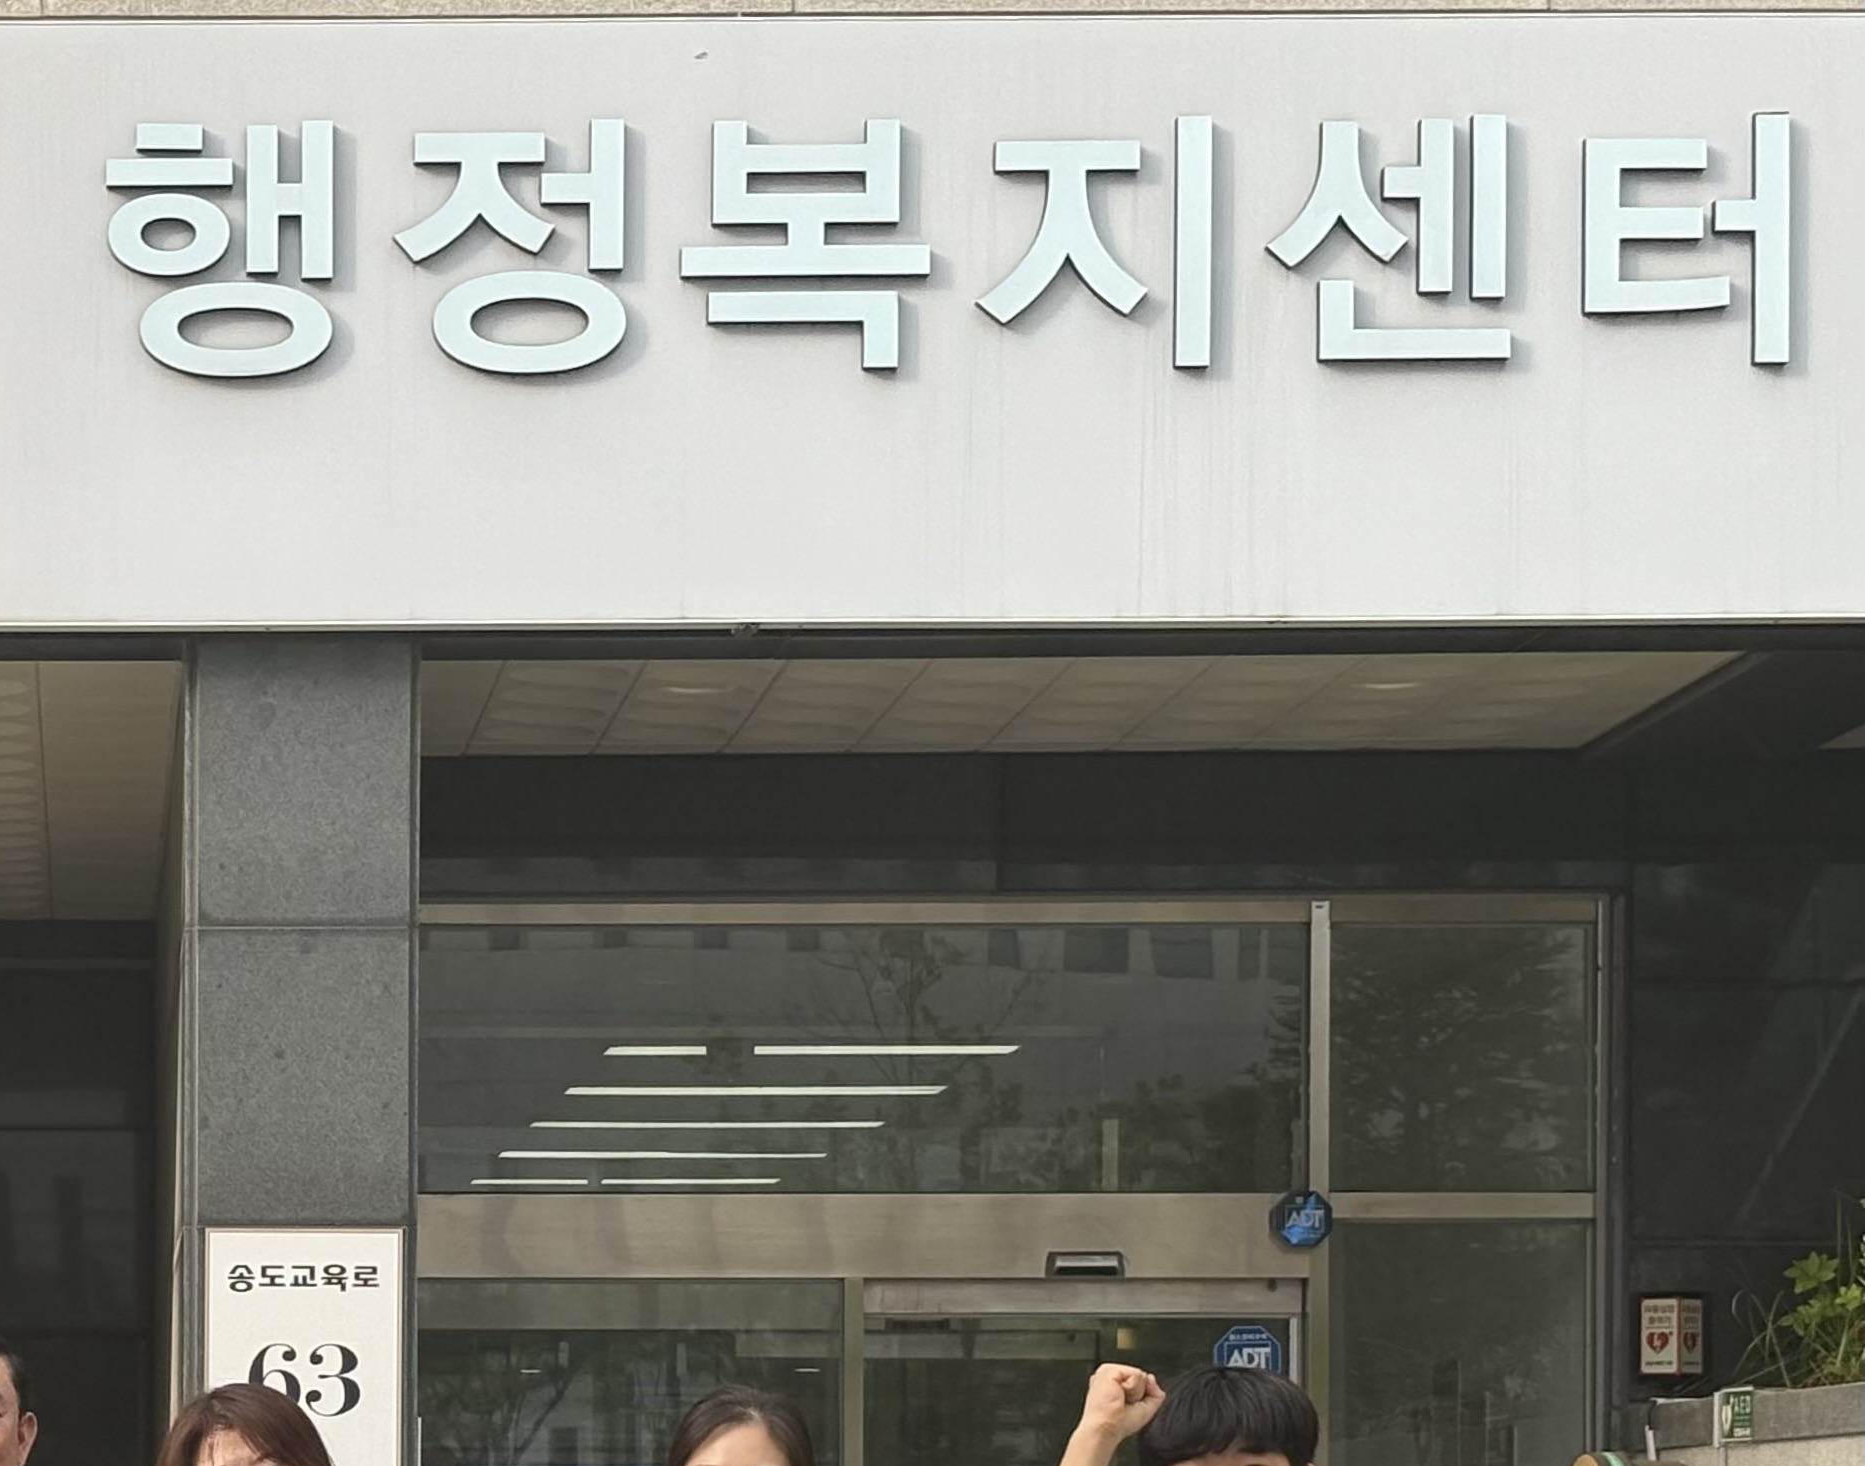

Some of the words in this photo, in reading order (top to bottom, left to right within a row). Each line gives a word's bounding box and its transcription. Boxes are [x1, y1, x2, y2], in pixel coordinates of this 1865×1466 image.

[106, 112, 1790, 377] 행정복지센터
[1285, 1209, 1325, 1228] ADT
[227, 1264, 380, 1293] 송도교육로
[1227, 1347, 1271, 1370] ADT
[248, 1342, 361, 1417] 63
